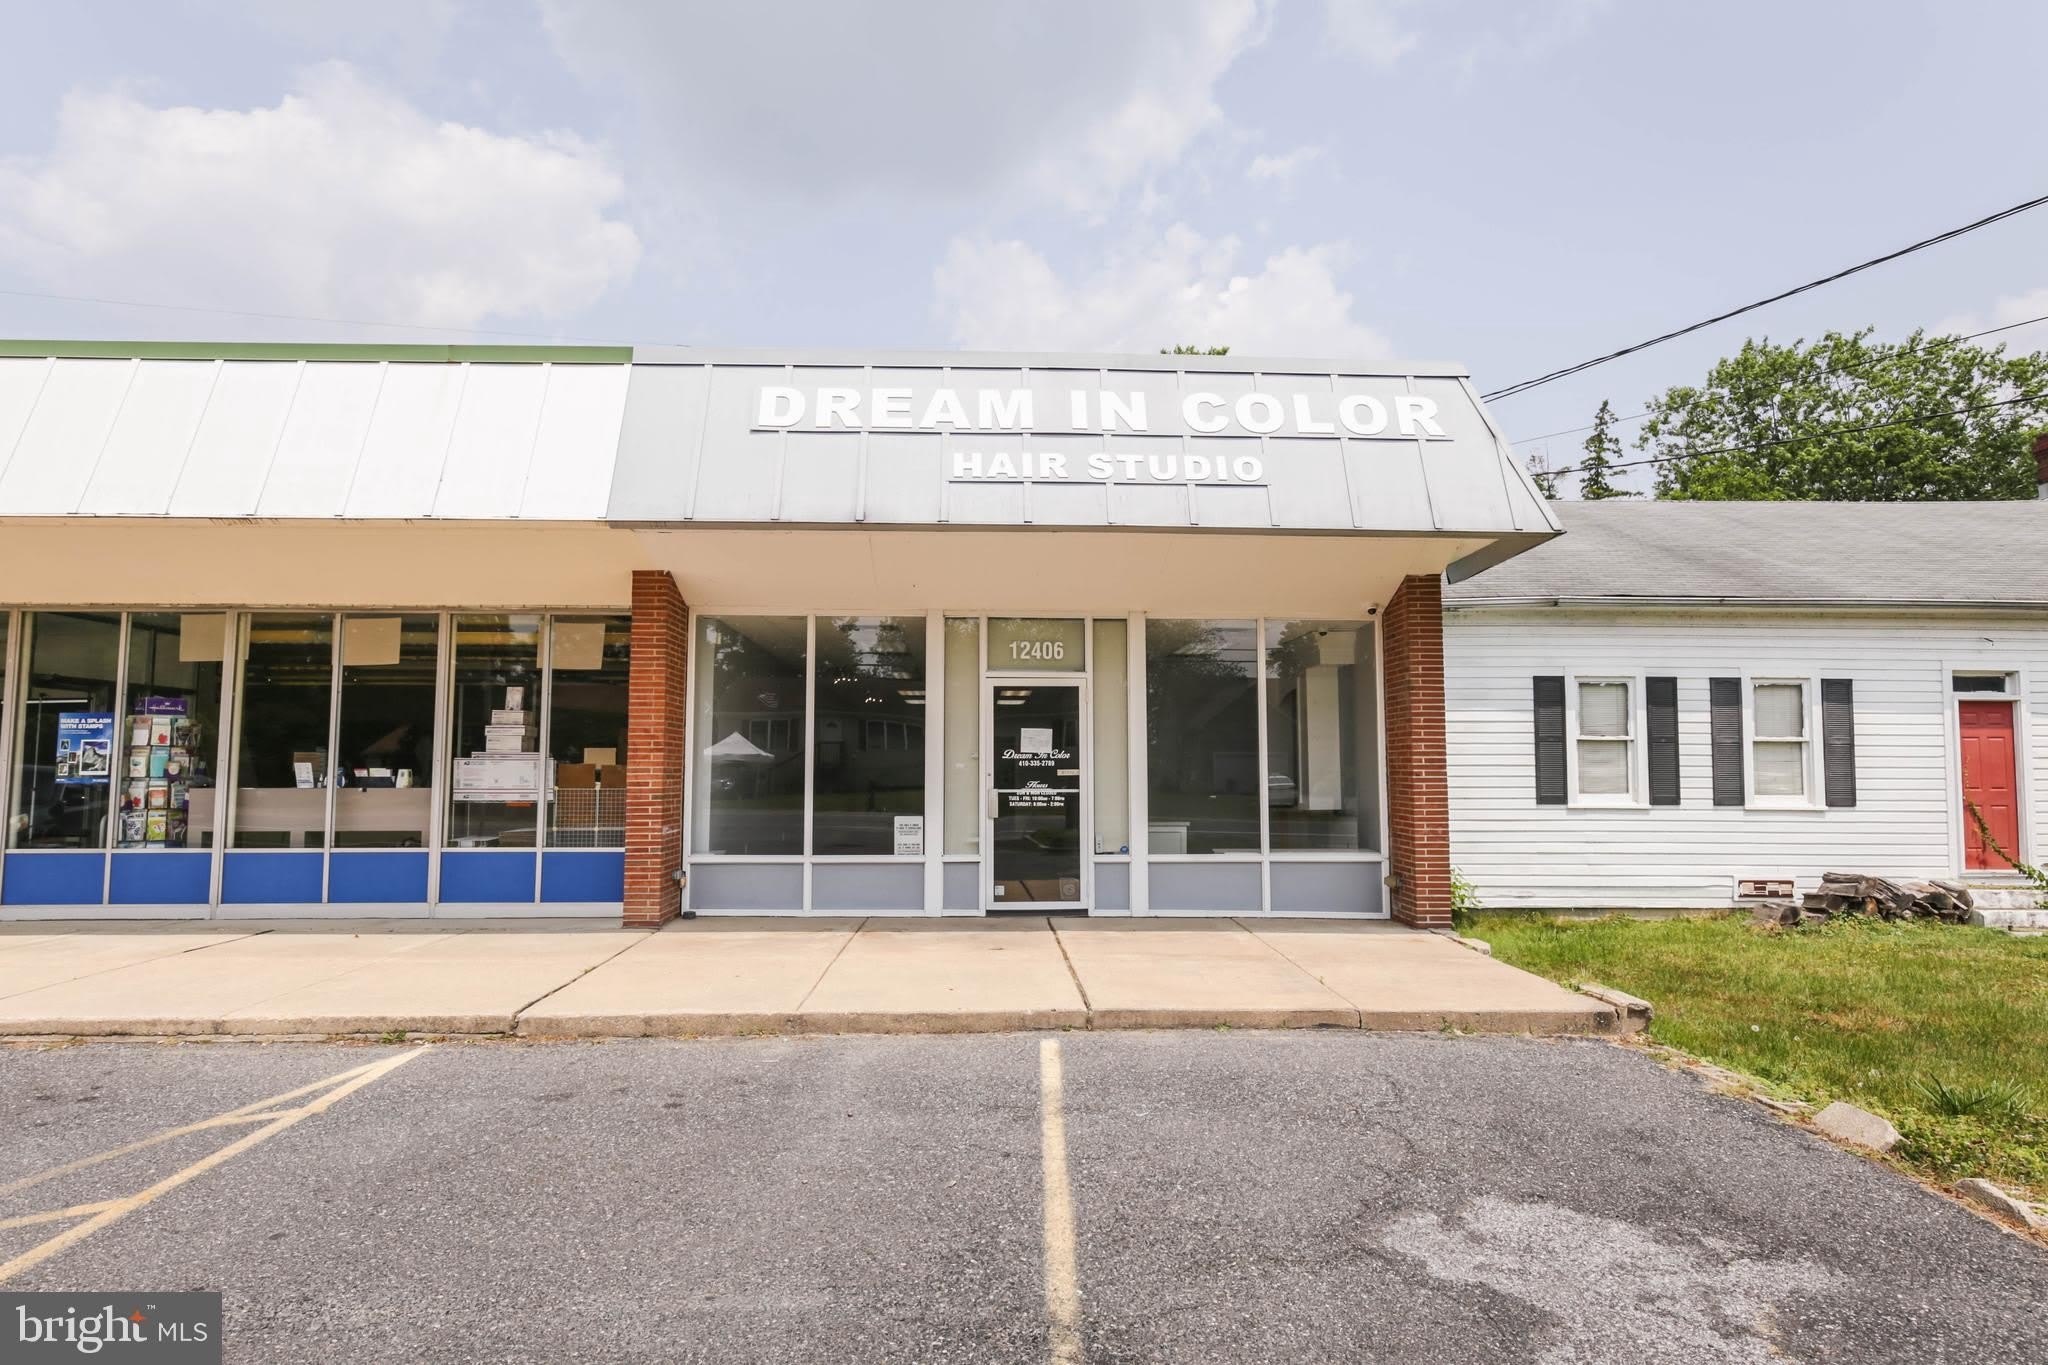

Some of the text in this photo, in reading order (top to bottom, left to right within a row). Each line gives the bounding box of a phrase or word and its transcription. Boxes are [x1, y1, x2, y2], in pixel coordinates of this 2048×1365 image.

[757, 386, 1446, 437] DREAM IN COLOR
[953, 452, 1264, 482] HAIR STUDIO
[1008, 641, 1064, 660] 12406
[148, 703, 185, 713] Hallmark
[1002, 748, 1033, 759] Dream
[1050, 749, 1071, 759] Color
